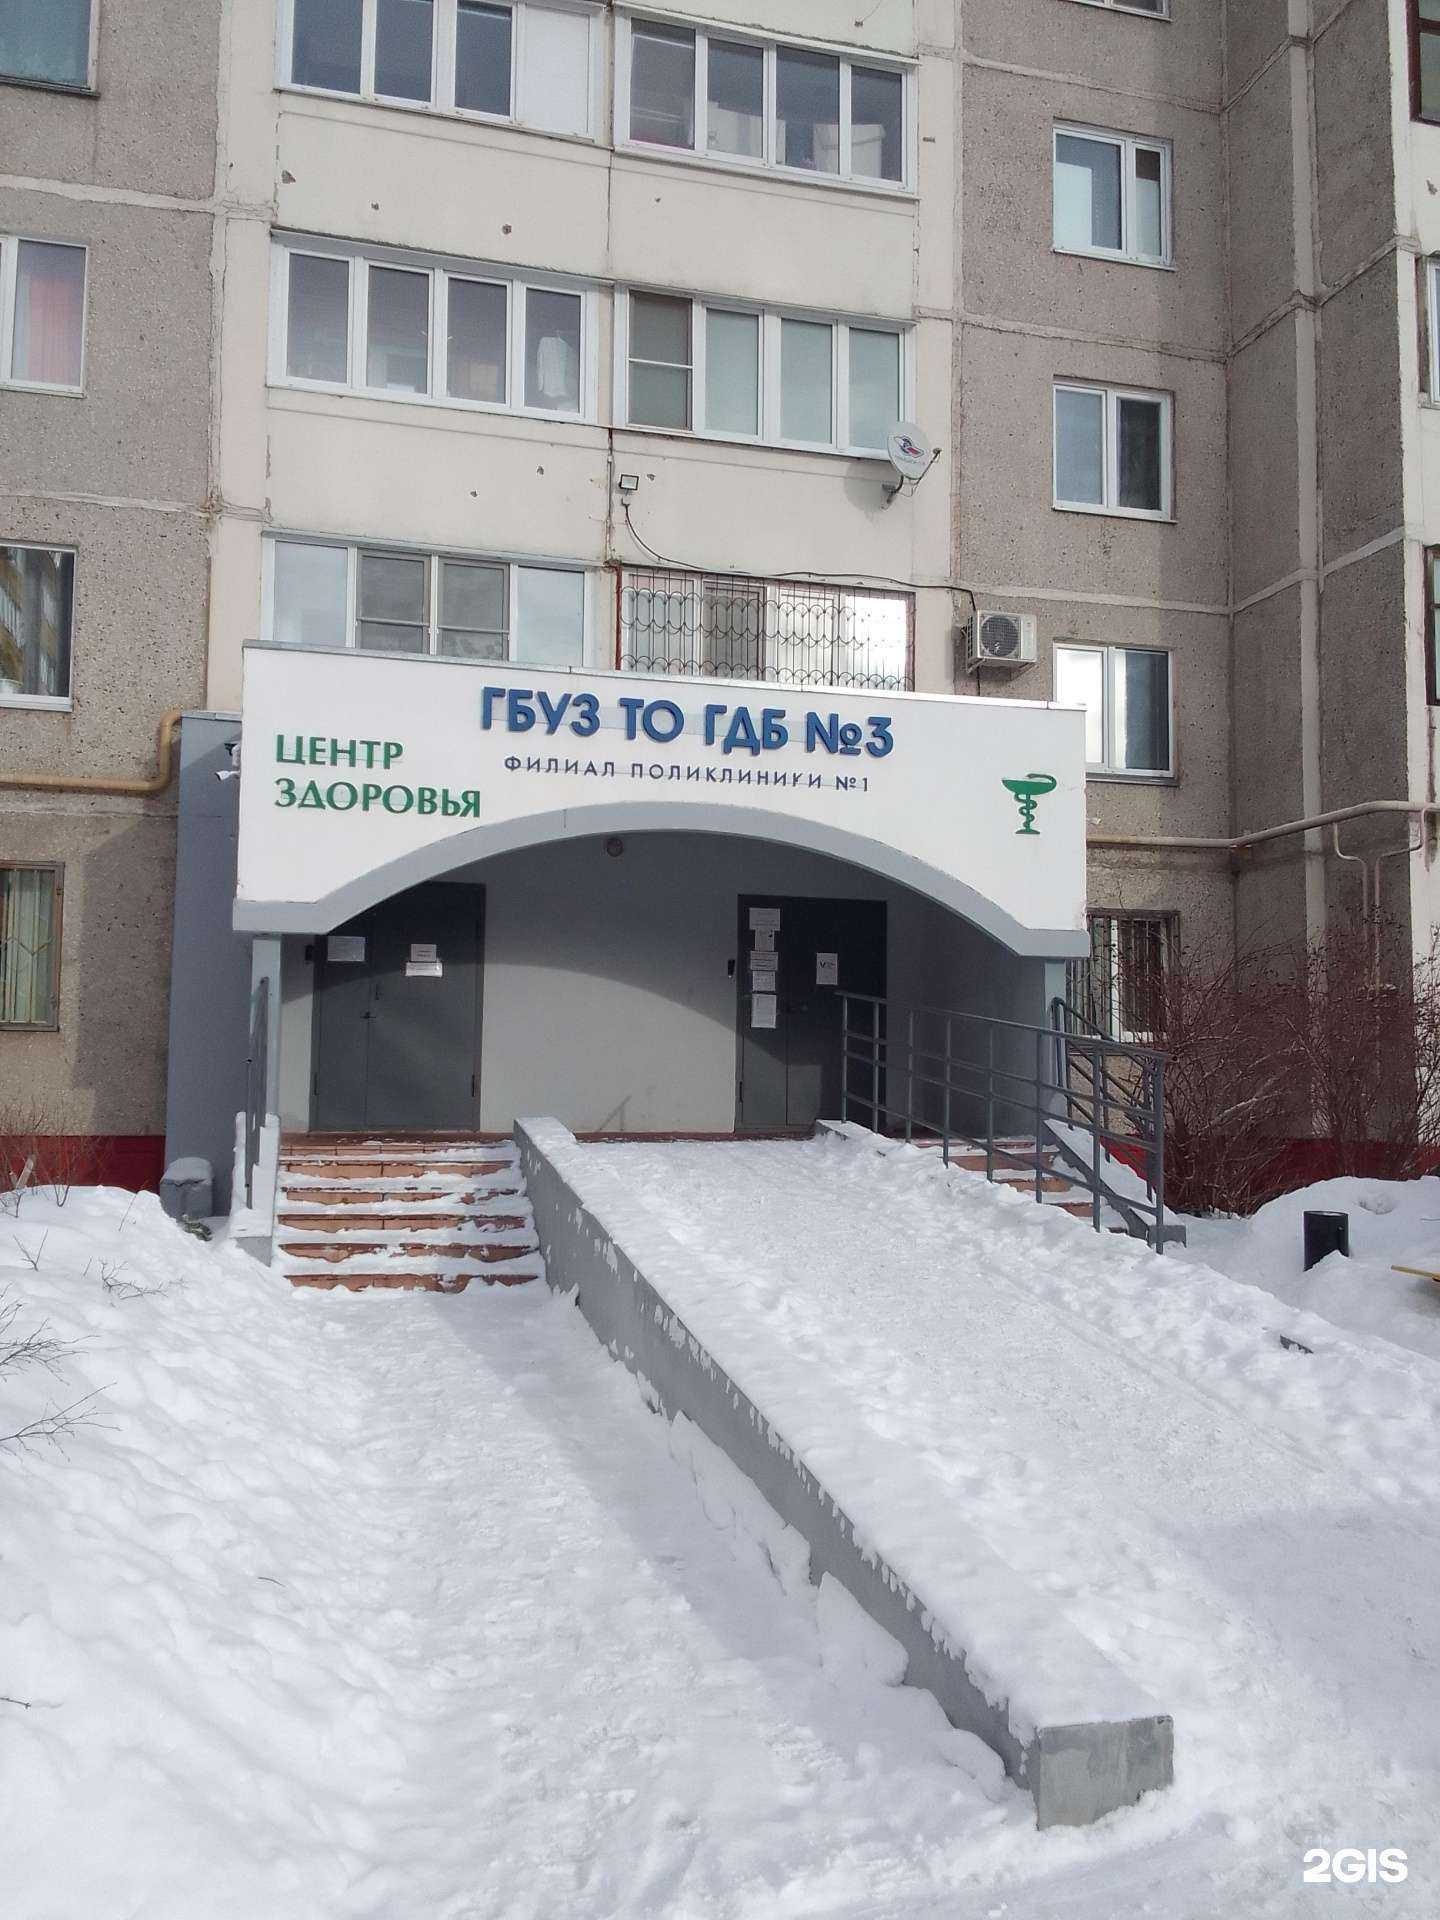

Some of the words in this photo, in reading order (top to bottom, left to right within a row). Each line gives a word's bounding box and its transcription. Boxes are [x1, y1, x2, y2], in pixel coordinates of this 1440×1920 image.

[481, 686, 601, 737] ГБУЗ
[619, 697, 685, 743] ТО
[704, 703, 789, 757] ГДБ
[805, 711, 894, 758] №3
[276, 734, 403, 769] ЦЕНТР
[504, 755, 615, 777] ФИЛИАЛ
[631, 763, 822, 789] ПОЛИКЛИНИКИ
[275, 777, 481, 818] ЗДОРОВЬЯ
